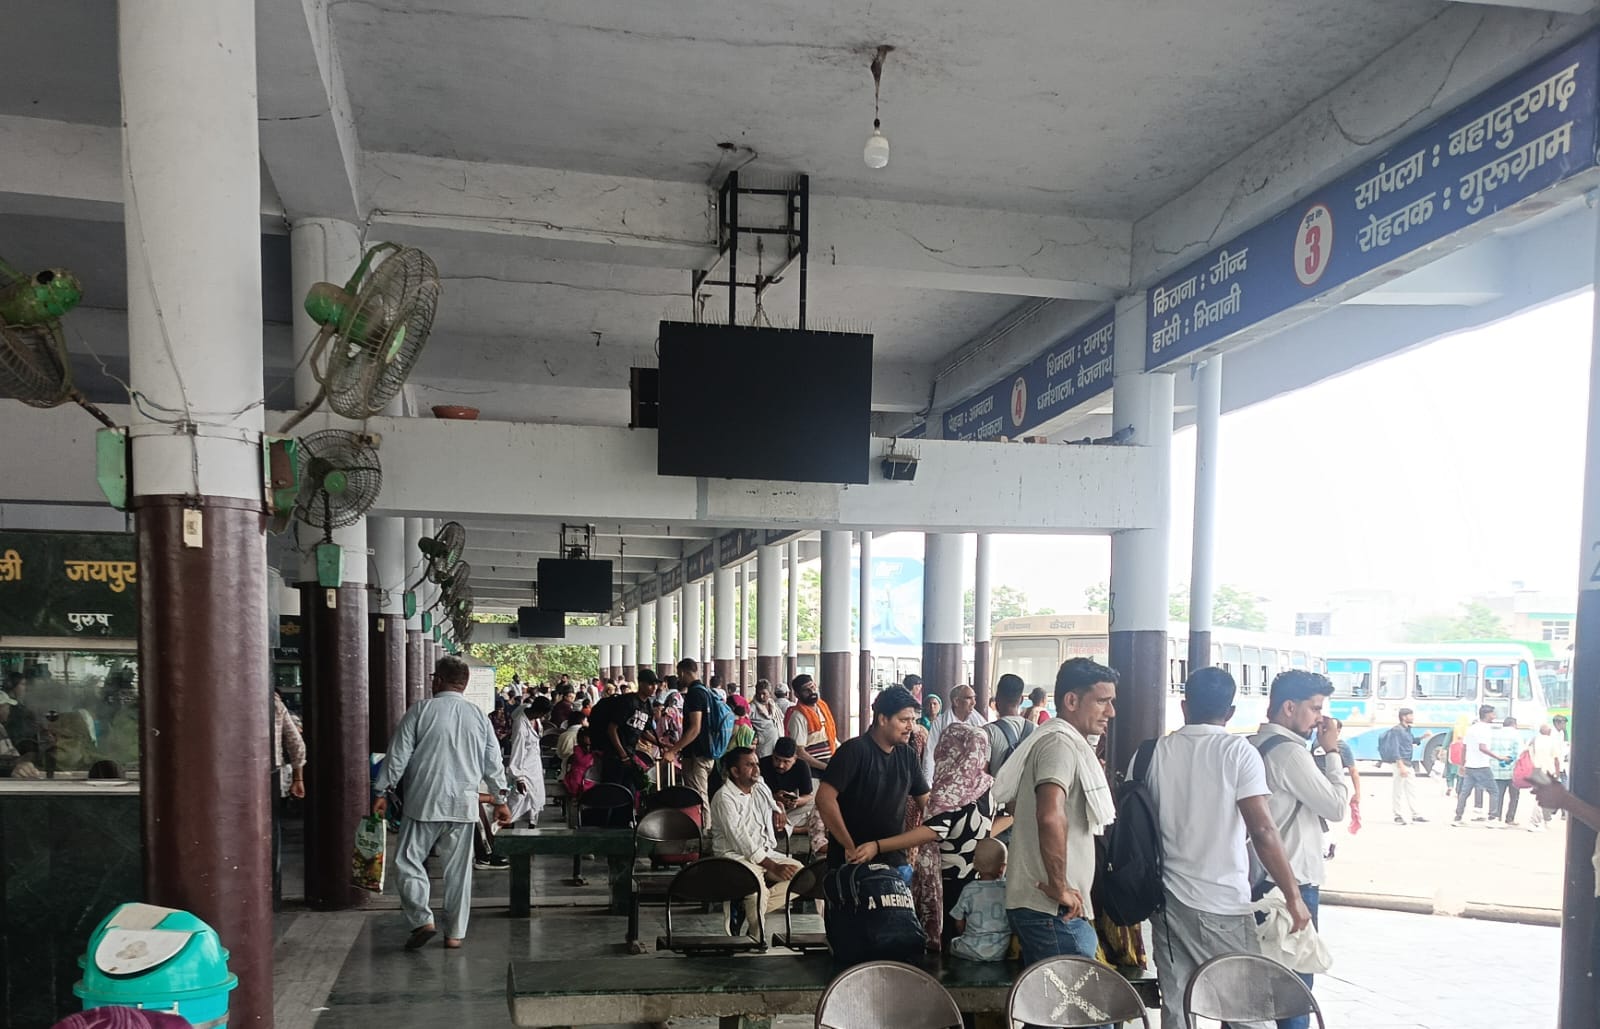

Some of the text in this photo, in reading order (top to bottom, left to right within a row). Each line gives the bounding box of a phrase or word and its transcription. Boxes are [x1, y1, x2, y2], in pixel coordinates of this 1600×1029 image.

[1354, 149, 1426, 210] सांपला
[1449, 62, 1580, 156] बहादुरगढ़
[1304, 225, 1321, 275] 3
[1359, 191, 1437, 252] रोहतक
[1153, 276, 1197, 318] किठाना
[1209, 248, 1249, 285] जीन्द
[1152, 313, 1182, 354] हांसी
[1193, 282, 1242, 333] भिवानी
[1046, 346, 1076, 378] शिमला
[1083, 321, 1114, 356] रामपुर
[1014, 389, 1023, 419] 4
[64, 559, 137, 593] जयपुर
